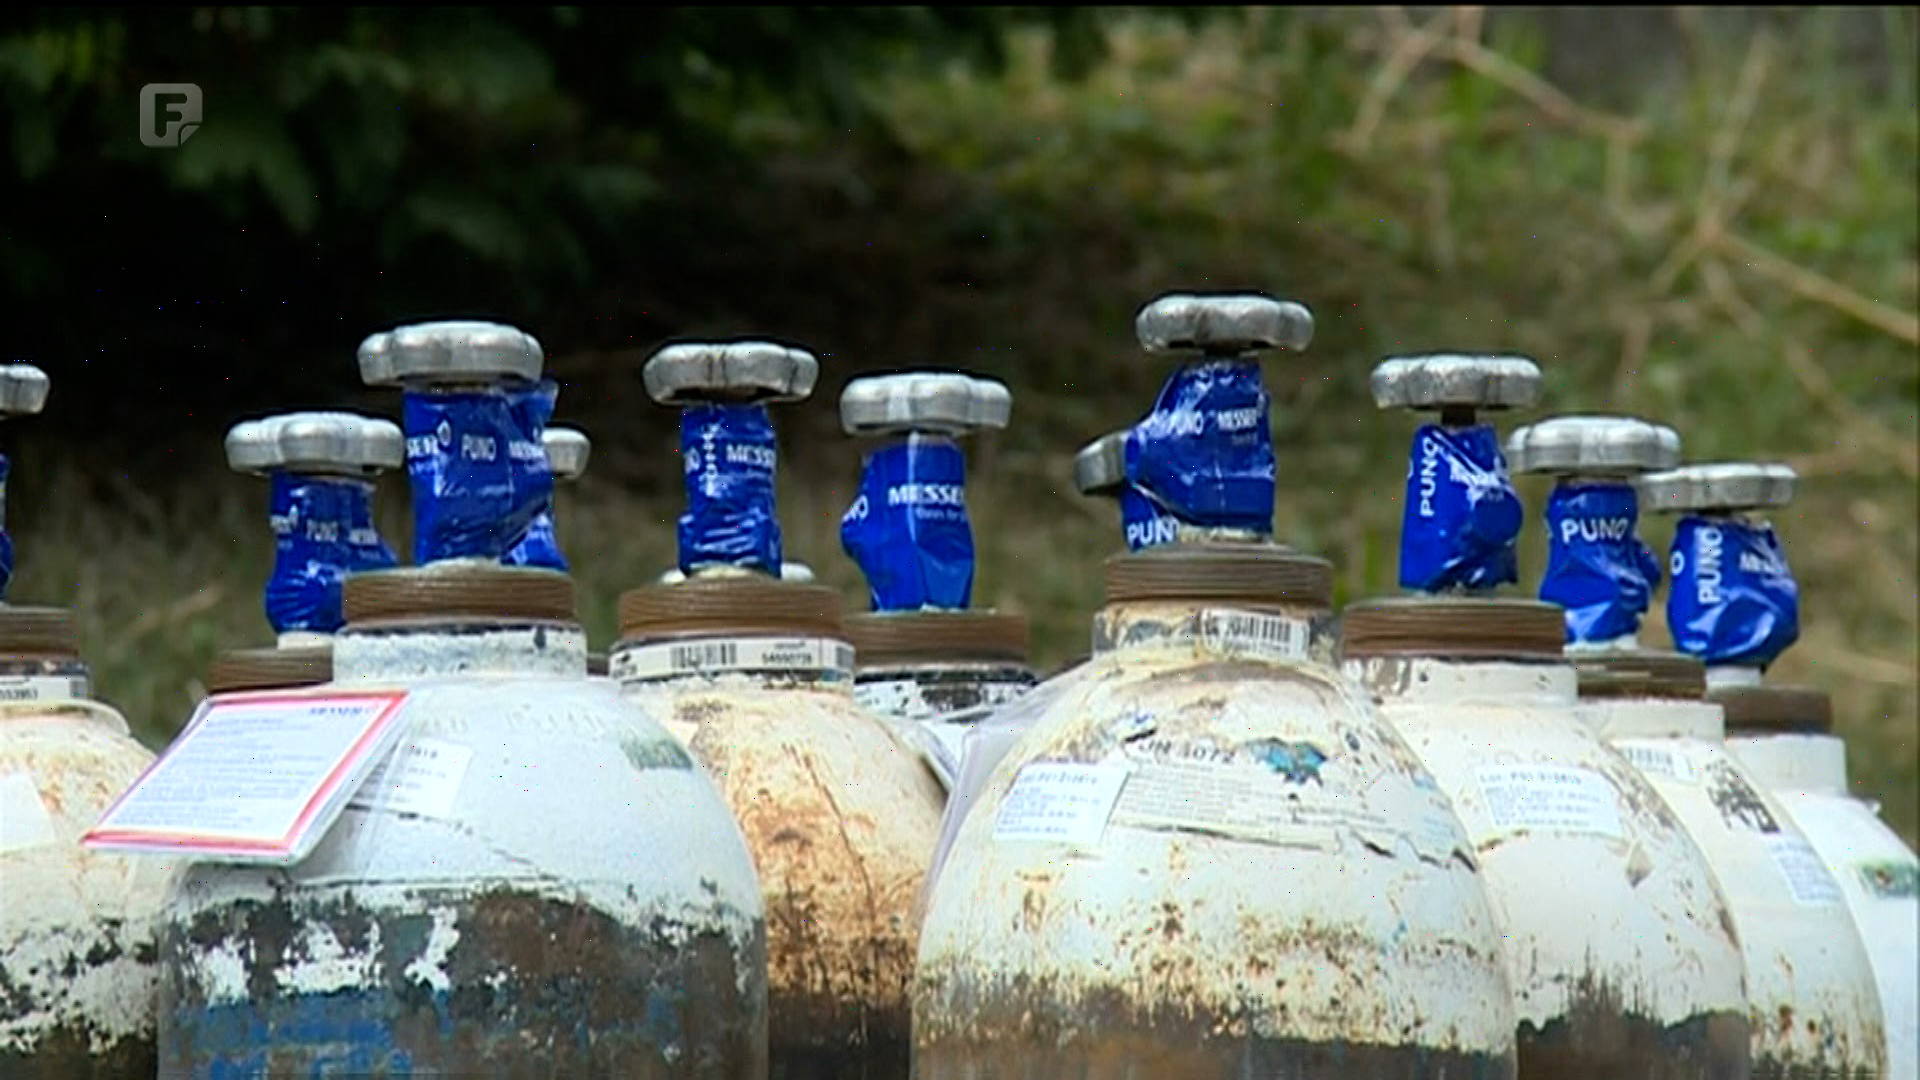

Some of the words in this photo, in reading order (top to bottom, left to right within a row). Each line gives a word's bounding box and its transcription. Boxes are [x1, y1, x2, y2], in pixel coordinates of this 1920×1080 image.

[1419, 436, 1440, 517] PUNO
[1560, 516, 1630, 544] PUNO
[1697, 526, 1723, 605] PUNO
